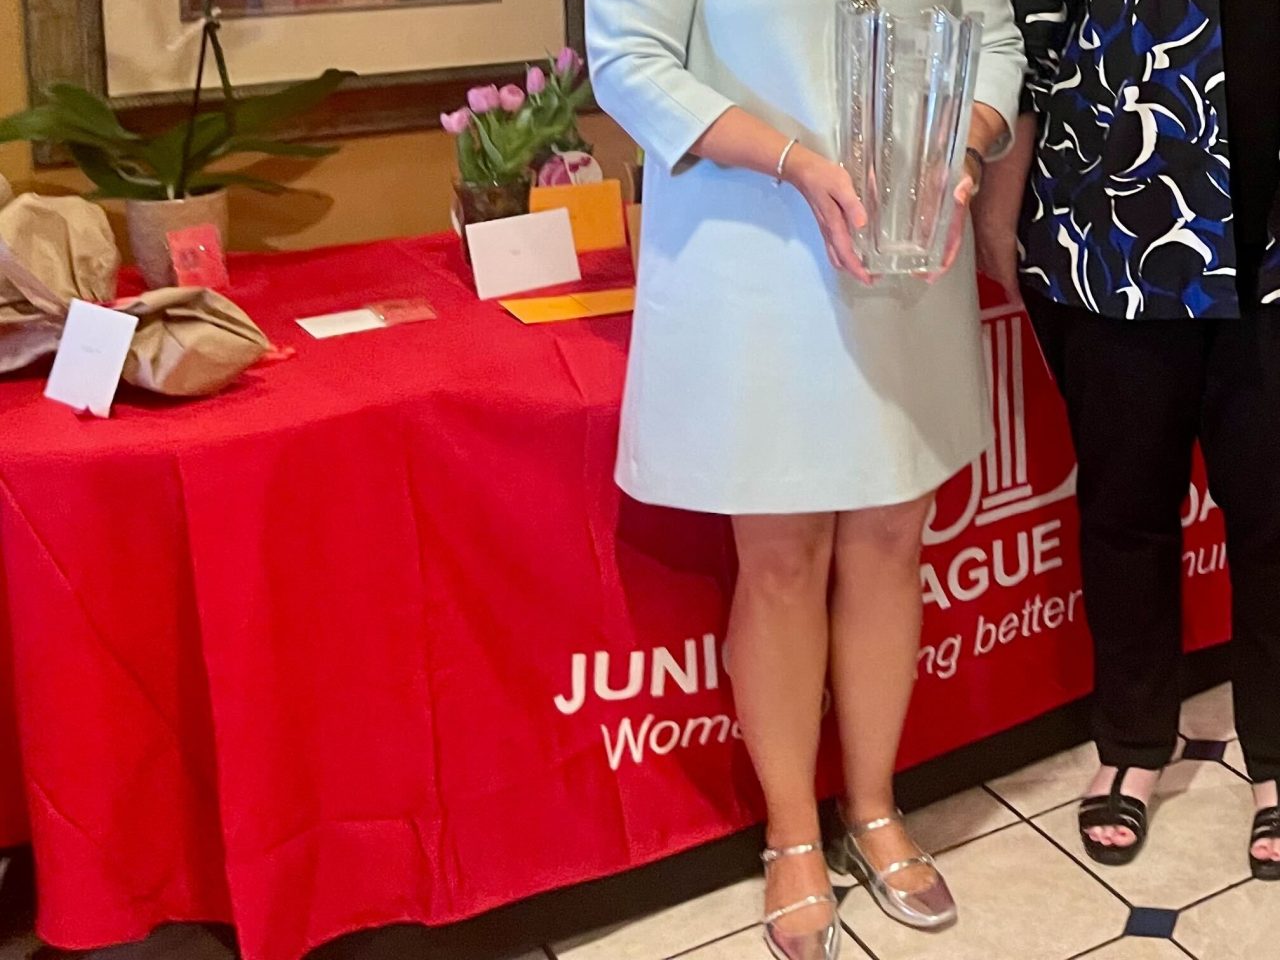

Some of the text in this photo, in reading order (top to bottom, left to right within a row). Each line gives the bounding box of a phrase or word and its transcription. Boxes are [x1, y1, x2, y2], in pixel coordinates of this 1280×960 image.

[554, 519, 1063, 715] JUNI AGUE
[601, 589, 1083, 771] Wom better
